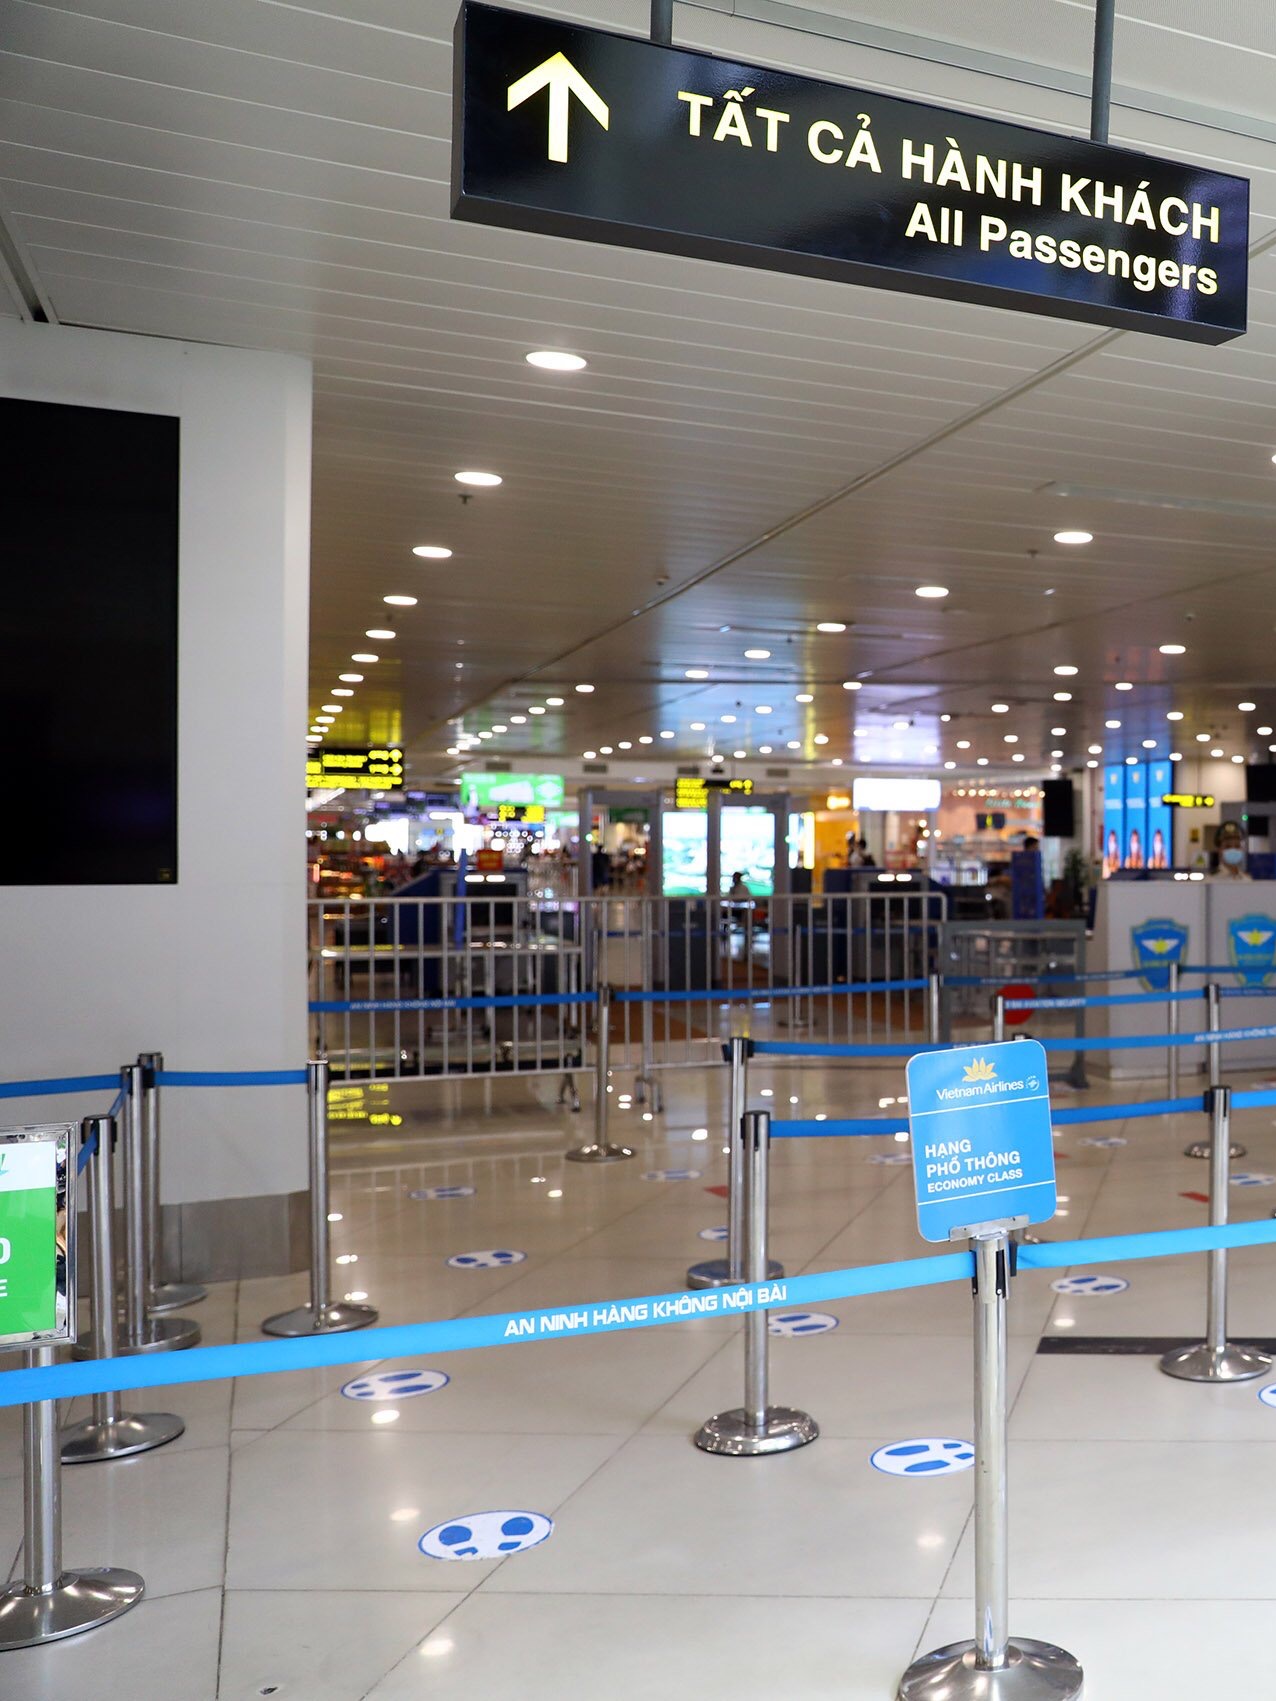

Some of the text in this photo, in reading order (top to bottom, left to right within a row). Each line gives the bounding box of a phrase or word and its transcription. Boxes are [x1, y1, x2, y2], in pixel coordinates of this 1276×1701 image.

[678, 87, 1220, 243] TẤT CẢ HÀNH KHÁCH
[904, 202, 1219, 295] All Passengers
[936, 1085, 984, 1101] Vietnam
[983, 1079, 1024, 1096] Airlines
[925, 1139, 972, 1159] HẠNG
[965, 1151, 1020, 1171] THÔNG
[927, 1169, 1023, 1193] ECONOMY CLASS
[504, 1283, 787, 1337] AN NINH HÀNG KHÔNG NỘI BÀI
